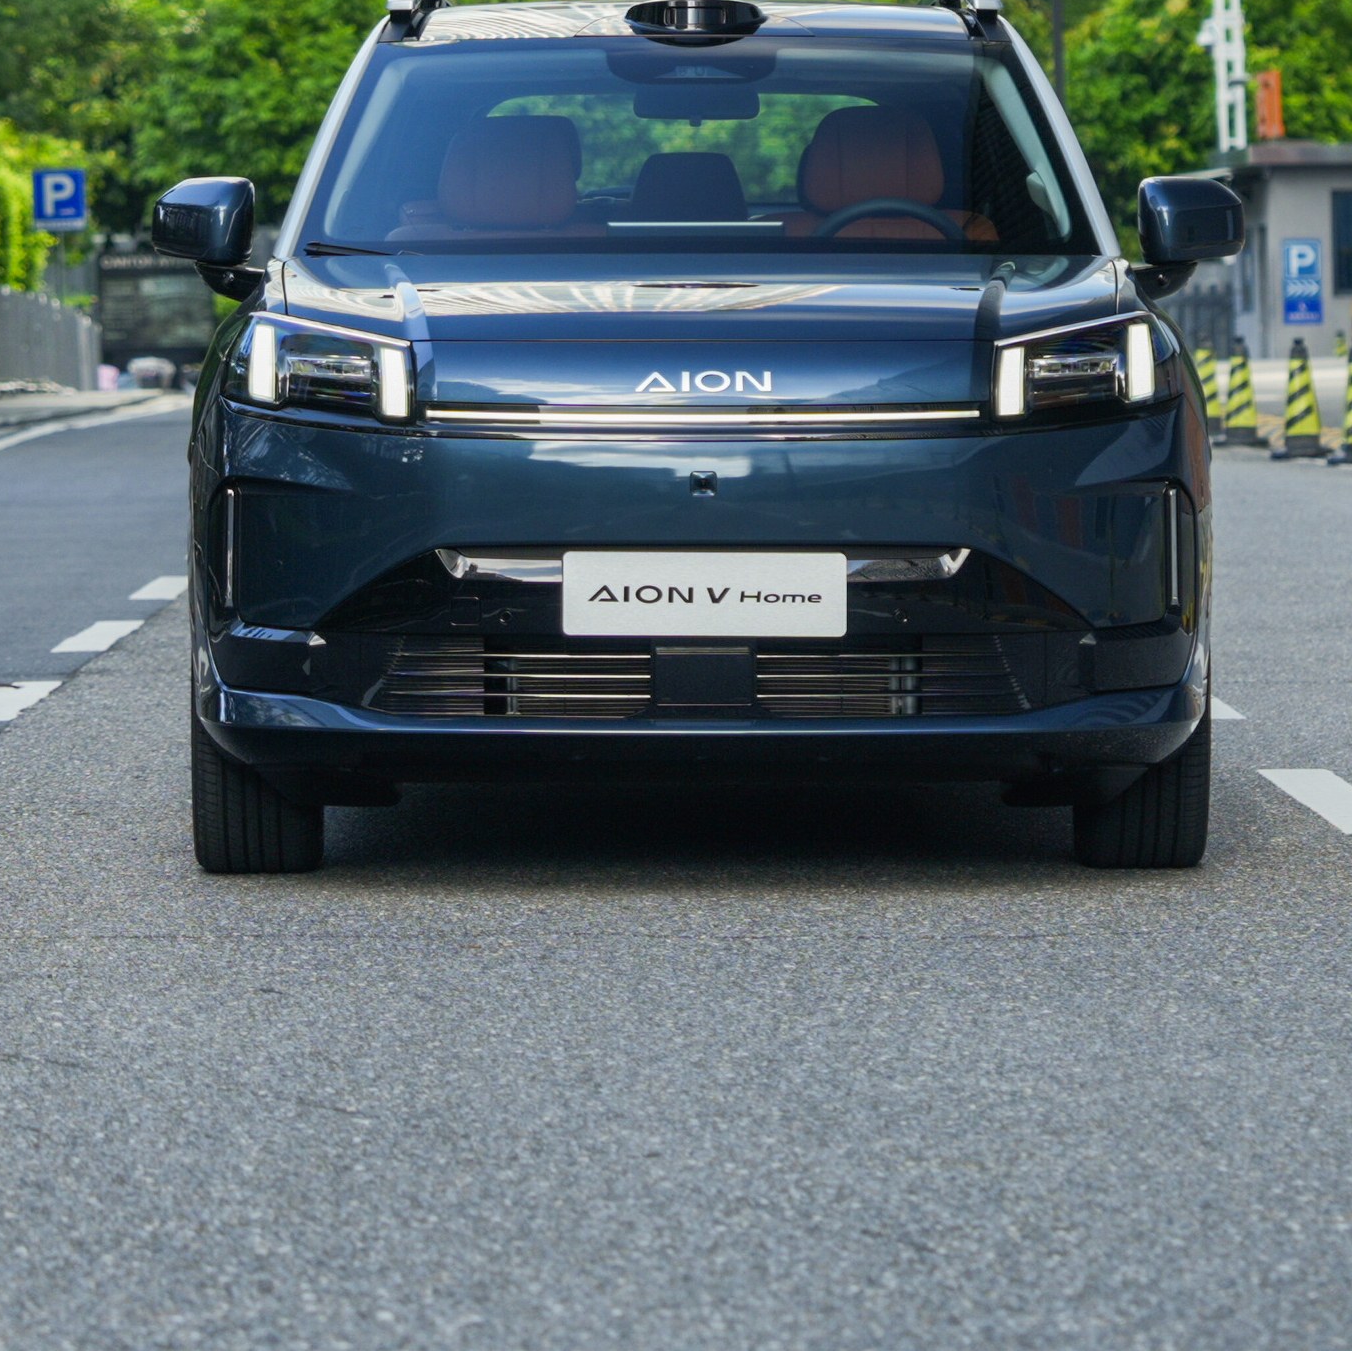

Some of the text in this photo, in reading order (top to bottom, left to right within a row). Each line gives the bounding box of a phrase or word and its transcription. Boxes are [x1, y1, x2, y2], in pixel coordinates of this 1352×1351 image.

[43, 174, 75, 217] P
[1289, 245, 1316, 278] P
[634, 370, 773, 393] AION
[587, 584, 822, 604] AION V Home
